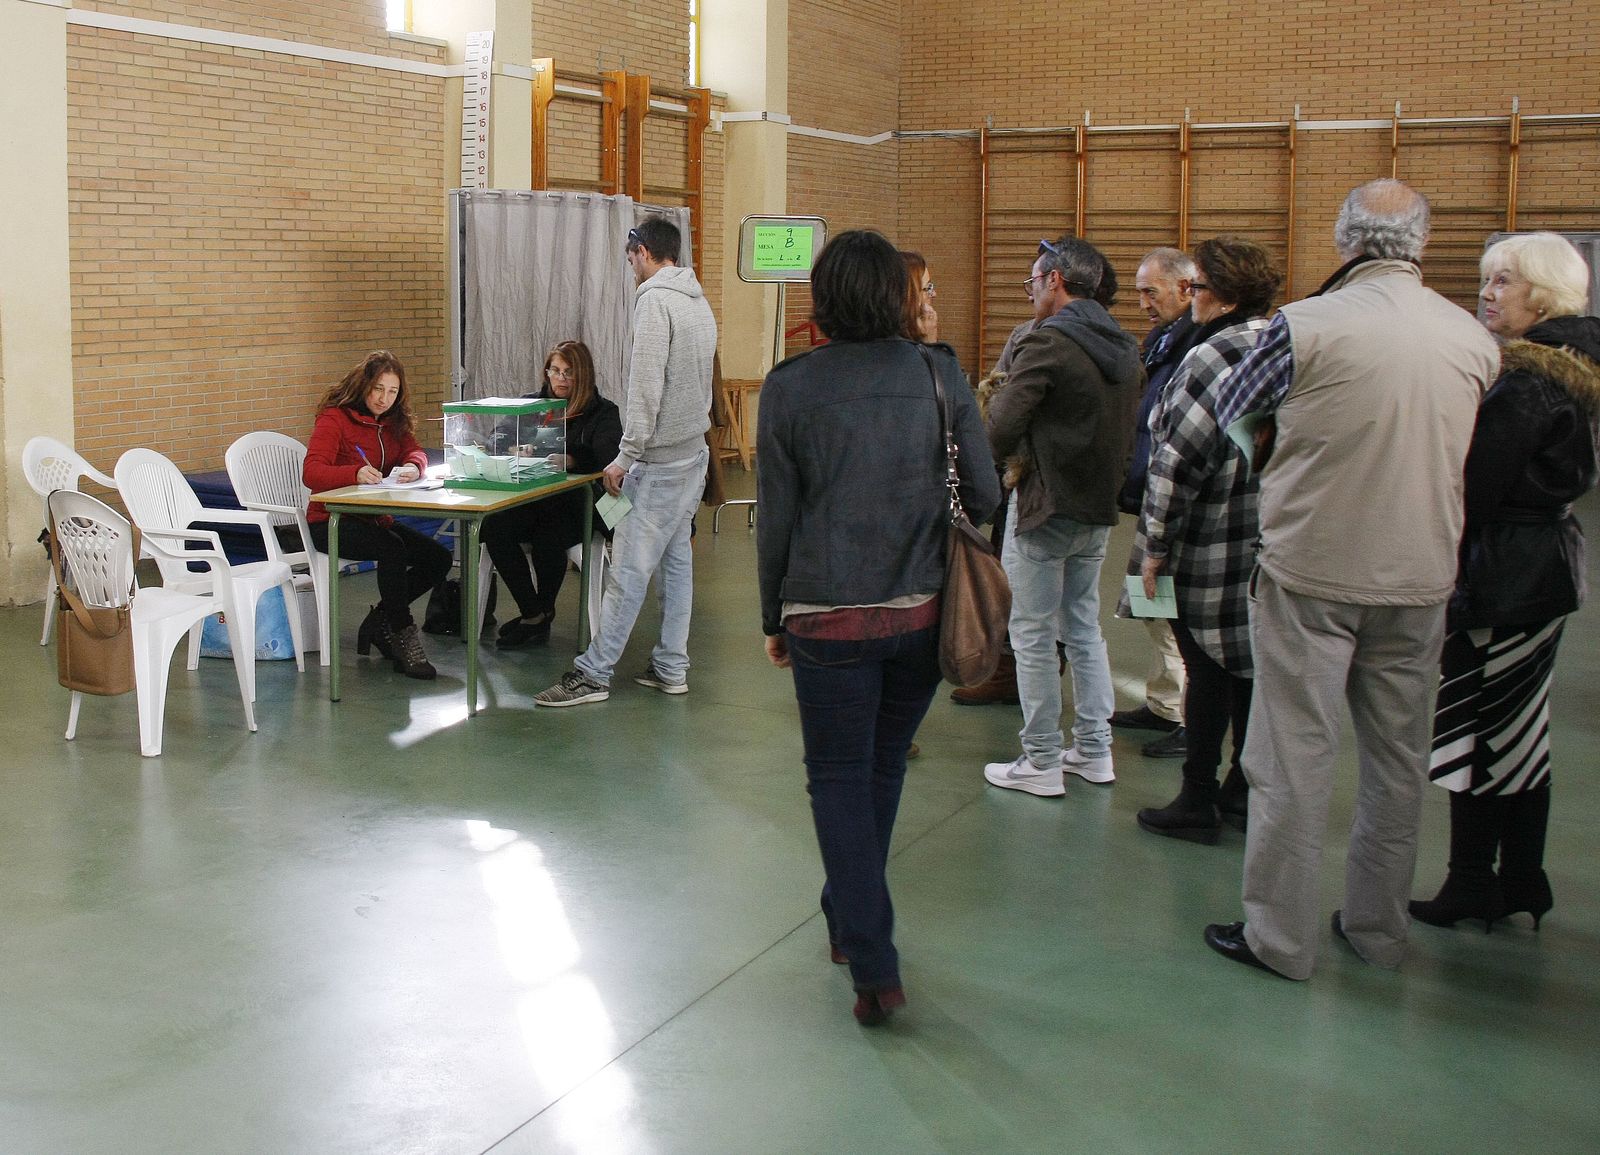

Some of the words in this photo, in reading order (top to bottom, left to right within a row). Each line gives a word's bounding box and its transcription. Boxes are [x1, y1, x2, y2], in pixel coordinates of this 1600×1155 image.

[482, 39, 491, 49] 20
[481, 55, 489, 64] 19
[480, 70, 488, 80] 18
[480, 86, 488, 95] 17
[479, 102, 487, 112] 16
[478, 118, 486, 127] 15
[478, 134, 486, 143] 14
[477, 150, 486, 160] 13
[477, 165, 486, 175] 12
[786, 228, 792, 236] 9
[785, 238, 794, 248] B
